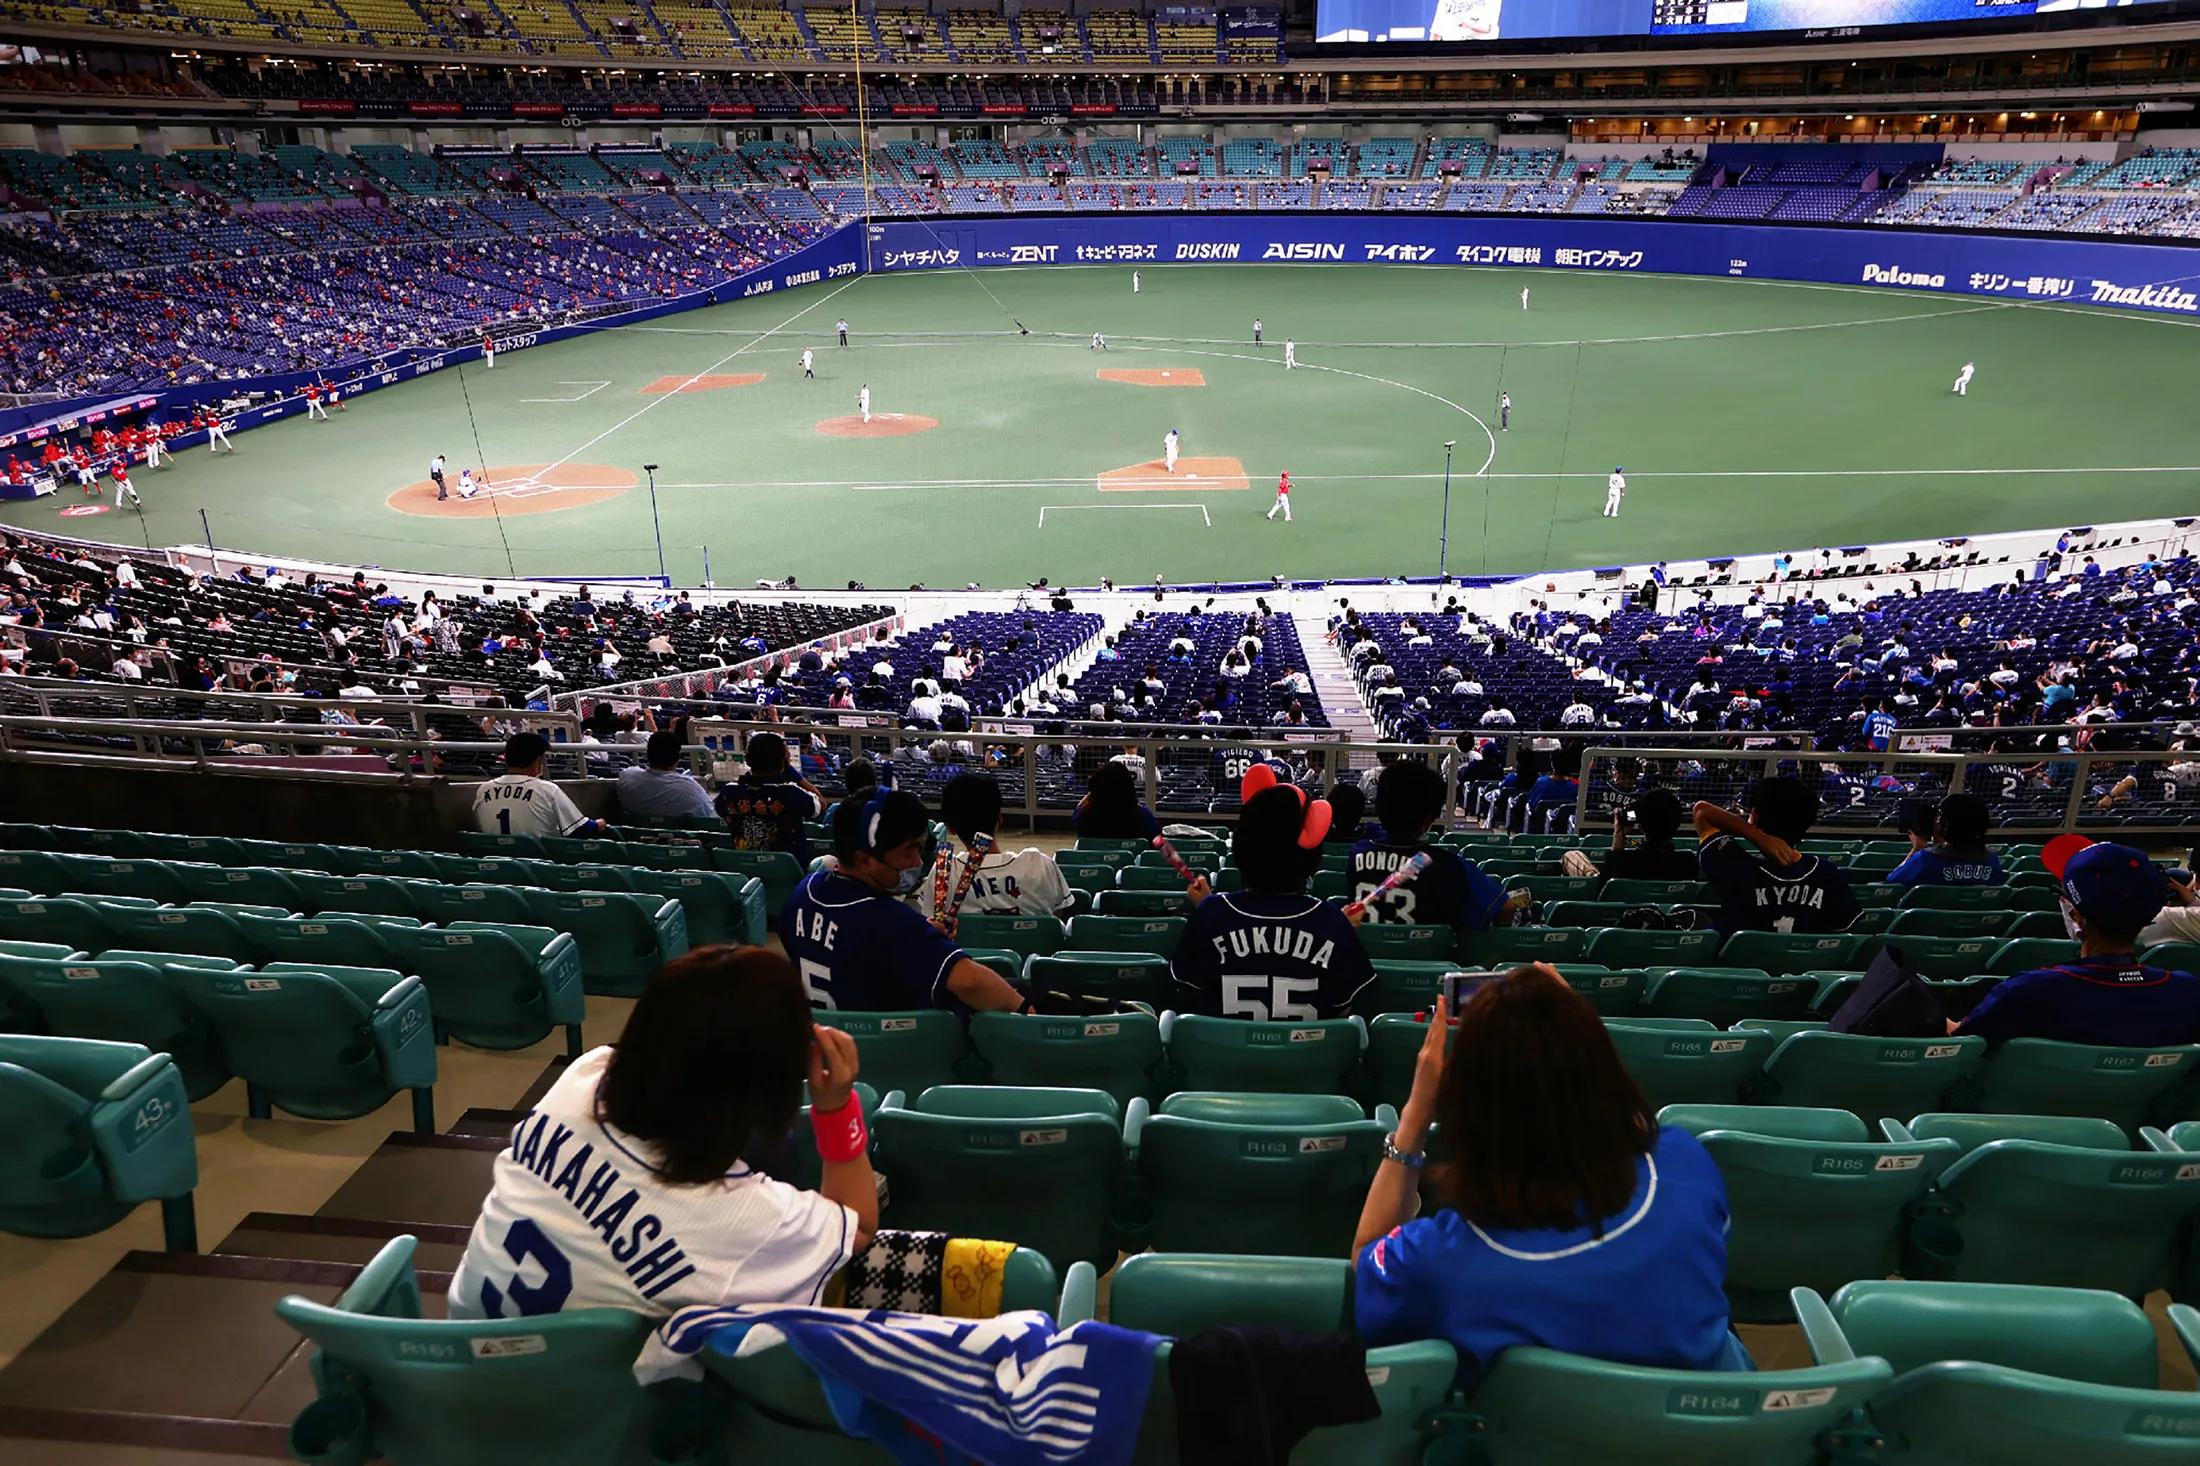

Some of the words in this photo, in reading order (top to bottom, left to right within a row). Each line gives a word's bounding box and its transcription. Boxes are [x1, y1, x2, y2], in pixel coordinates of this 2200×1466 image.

[884, 249, 960, 267] シヤチハタ
[1010, 246, 1059, 262] ZENT
[1176, 243, 1240, 259] DUSKIN
[1263, 243, 1345, 260] AISIN
[1364, 244, 1436, 261] アイホン
[1456, 246, 1541, 264] ダイコク電機
[1555, 249, 1643, 268] 朝日インテック
[1863, 264, 1945, 288] Paloma
[219, 419, 238, 432] BC
[1225, 758, 1247, 779] 66
[484, 785, 533, 803] KYODA
[1850, 786, 1866, 806] 2
[2002, 777, 2017, 799] 2
[2164, 782, 2177, 801] 8
[496, 808, 511, 835] 1
[1943, 864, 1993, 881] SOBUE
[795, 908, 839, 951] ABE
[1773, 915, 1796, 934] 1
[1212, 926, 1336, 970] FUKUDA
[799, 956, 838, 1011] 5
[1221, 974, 1319, 1022] 55
[400, 1008, 419, 1035] 42
[844, 1021, 873, 1031] R161
[1046, 1026, 1077, 1037] R162
[1251, 1031, 1282, 1042] R163
[1670, 1041, 1702, 1053] R165
[1884, 1048, 1916, 1060] R166
[2102, 1055, 2136, 1067] R167
[133, 1097, 164, 1132] 43
[1246, 1141, 1288, 1154] R163
[1821, 1157, 1864, 1170] R165
[2119, 1166, 2164, 1180] R166
[512, 1109, 696, 1301] TAKAHASHI
[480, 1218, 573, 1320] 3
[399, 1341, 456, 1357] R161
[1680, 1394, 1741, 1410] R164
